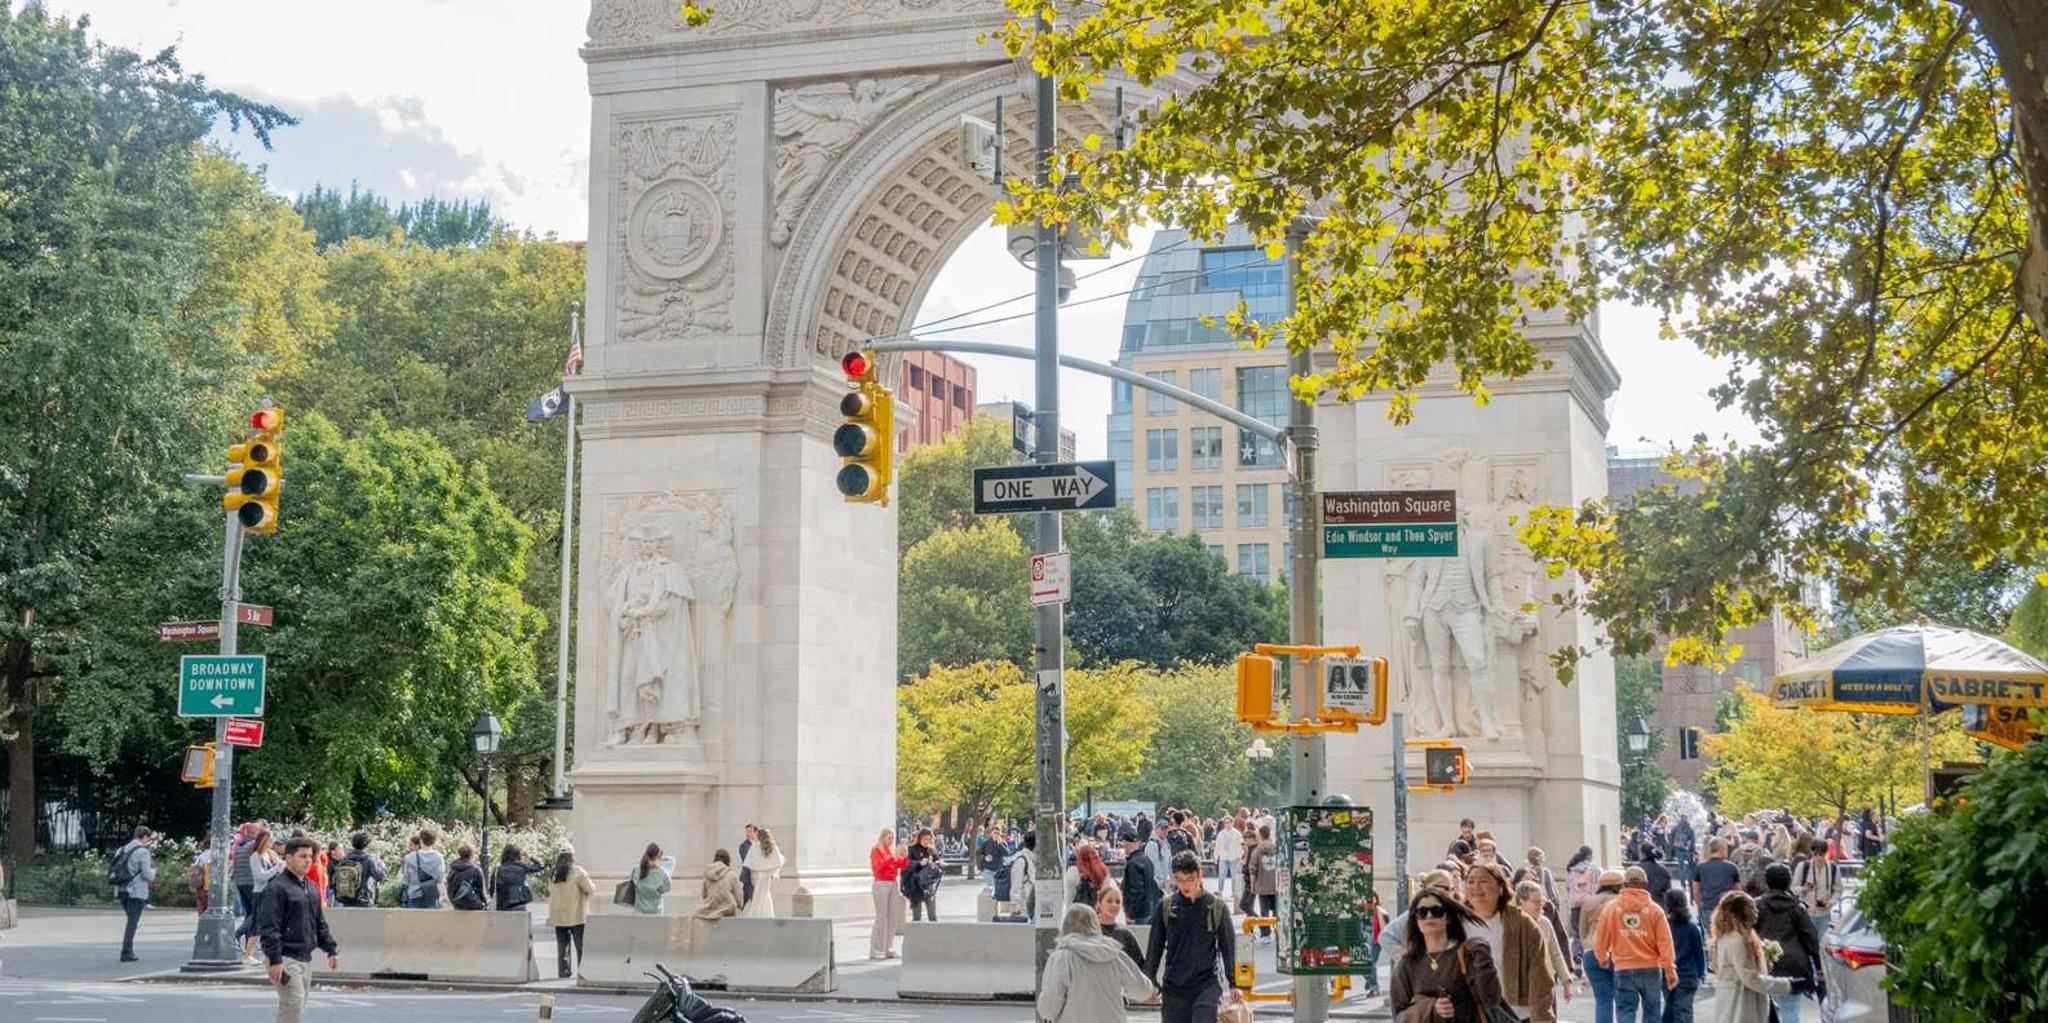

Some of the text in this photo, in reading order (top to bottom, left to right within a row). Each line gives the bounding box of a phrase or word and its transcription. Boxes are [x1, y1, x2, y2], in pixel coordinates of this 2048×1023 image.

[994, 477, 1094, 499] ONE WAY
[1325, 497, 1452, 517] Washington Square
[1326, 528, 1453, 544] Edie Windsor and Thea Spyer
[1381, 544, 1398, 554] Way
[162, 626, 197, 637] Washington
[191, 662, 254, 675] BROADWAY
[190, 678, 256, 691] DOWNTOWN
[1933, 677, 2044, 699] SABRETT
